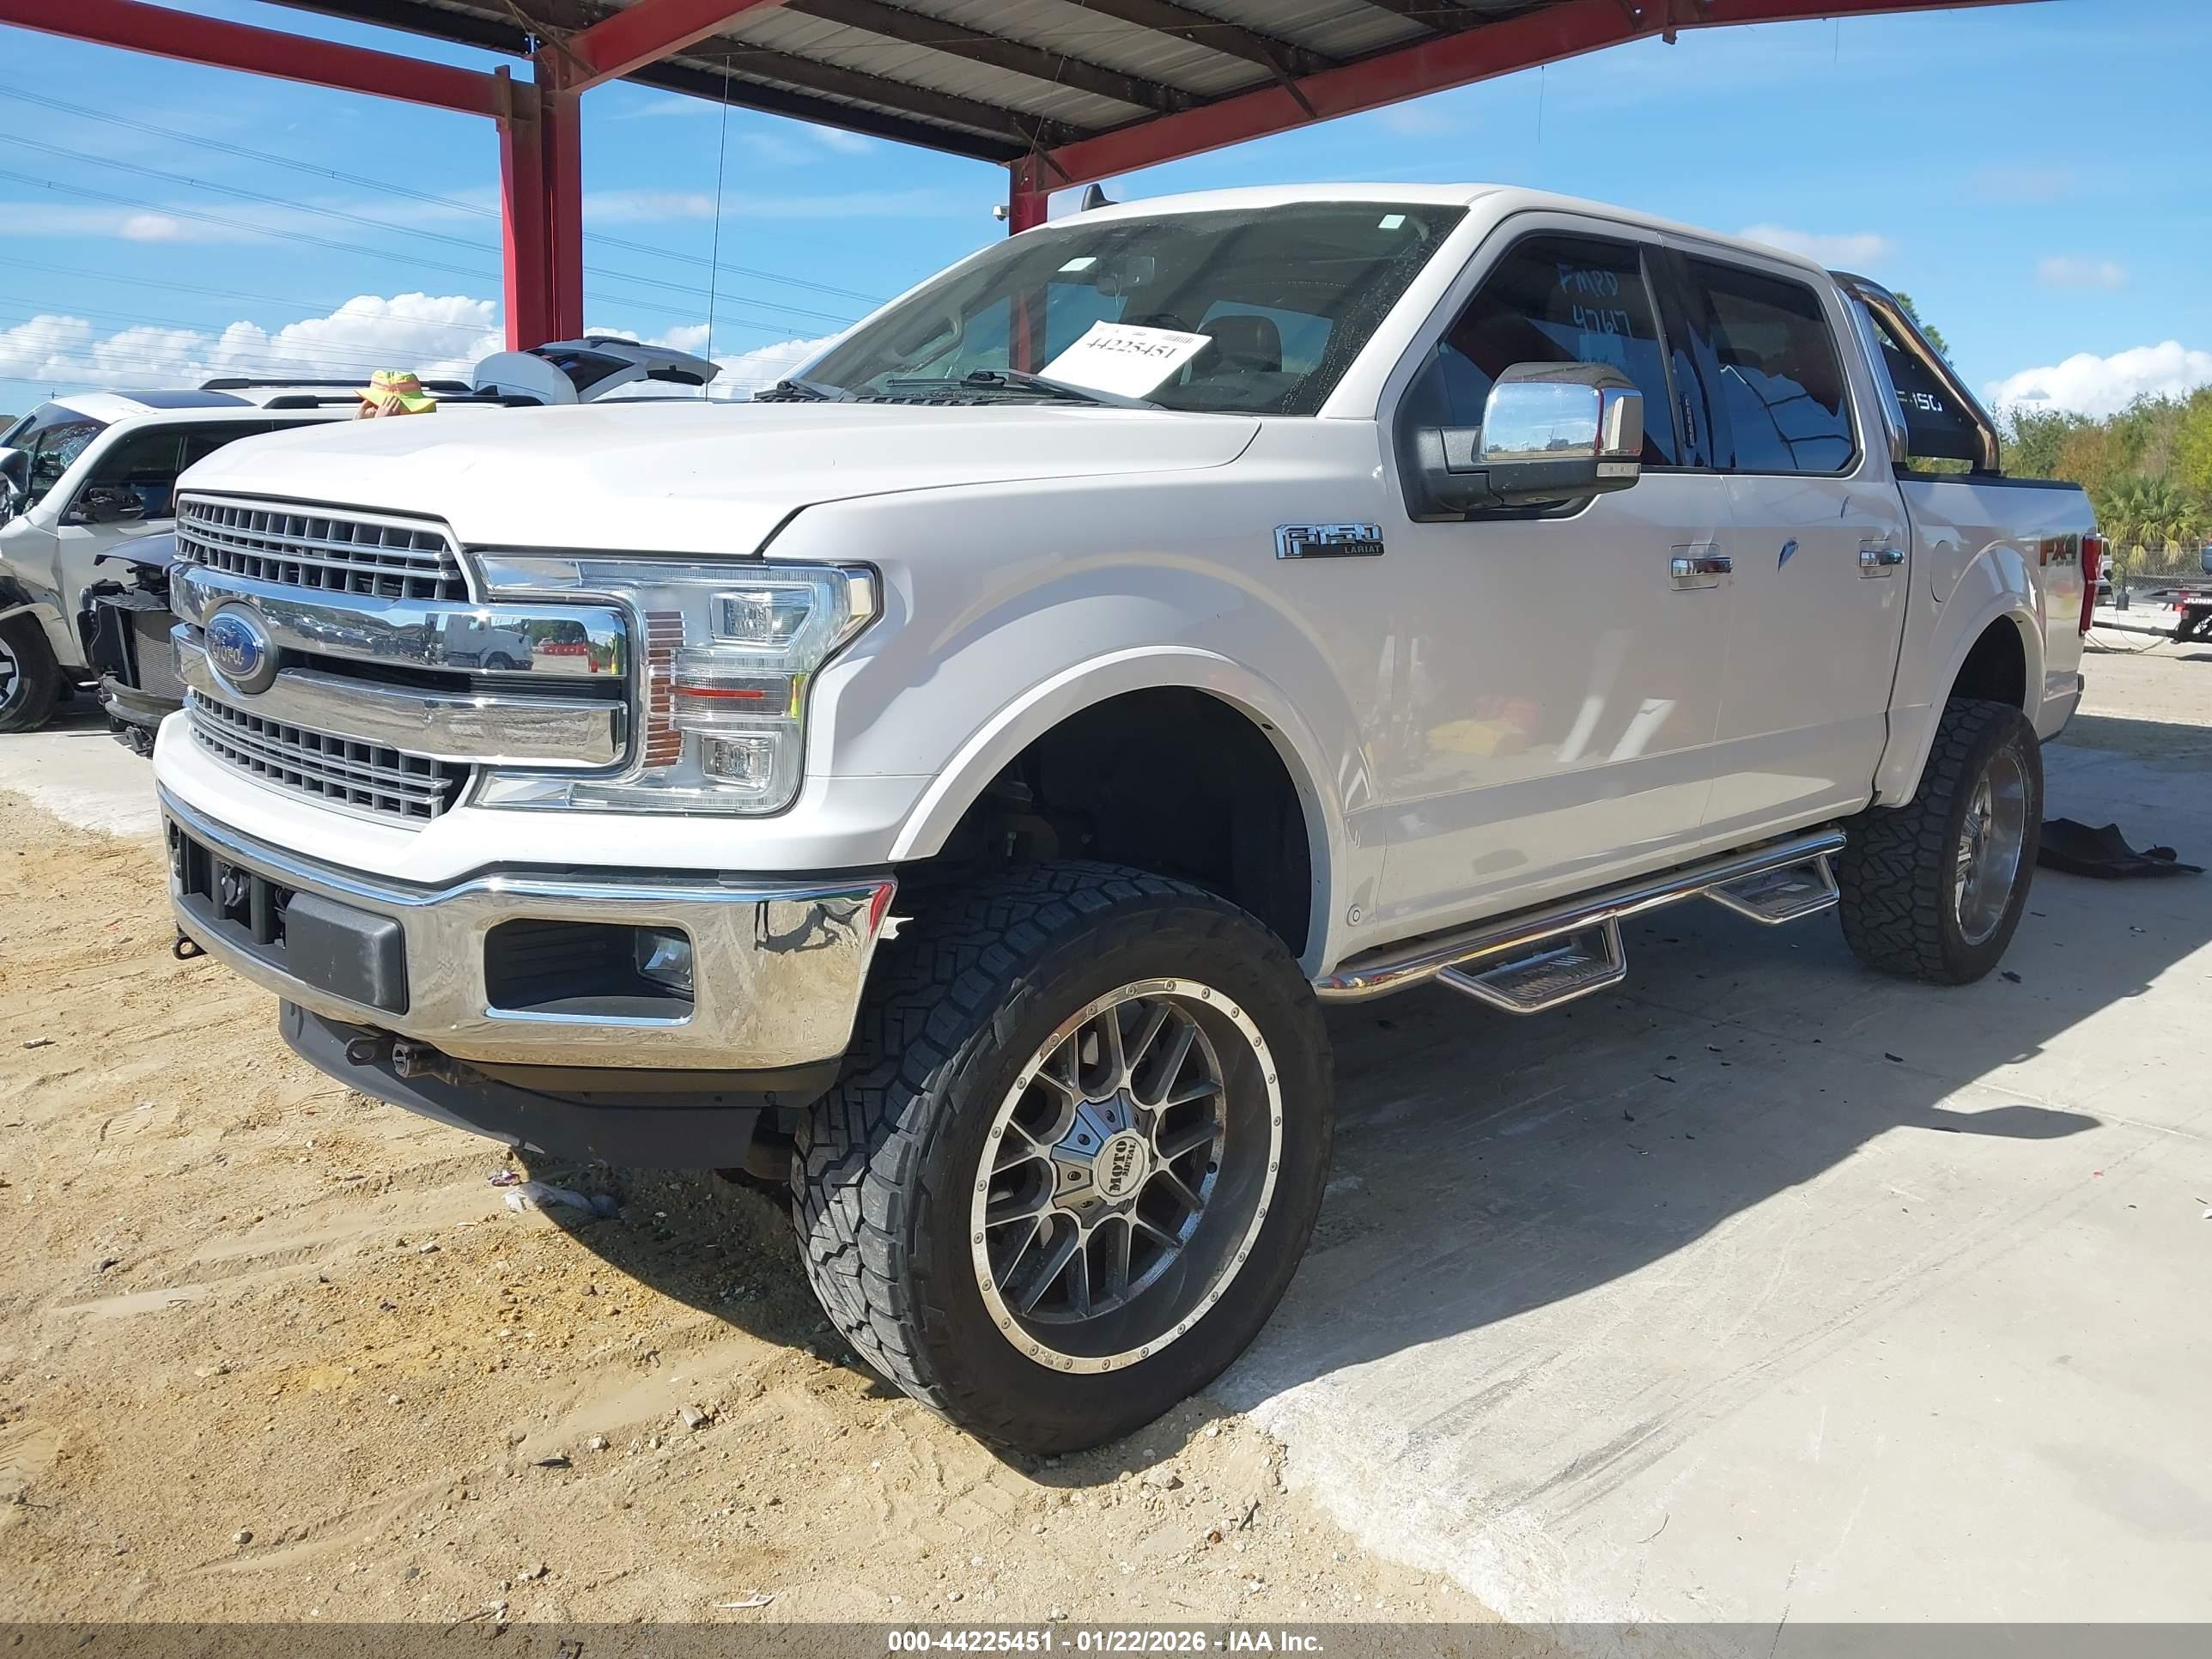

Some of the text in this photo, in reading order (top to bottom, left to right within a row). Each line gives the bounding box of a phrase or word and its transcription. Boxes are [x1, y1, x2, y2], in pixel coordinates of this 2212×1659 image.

[1086, 337, 1179, 359] 44225451
[1344, 544, 1381, 554] LARIAT
[210, 626, 246, 665] Ford
[1109, 1140, 1127, 1193] MOTO
[1121, 1142, 1137, 1177] METAL
